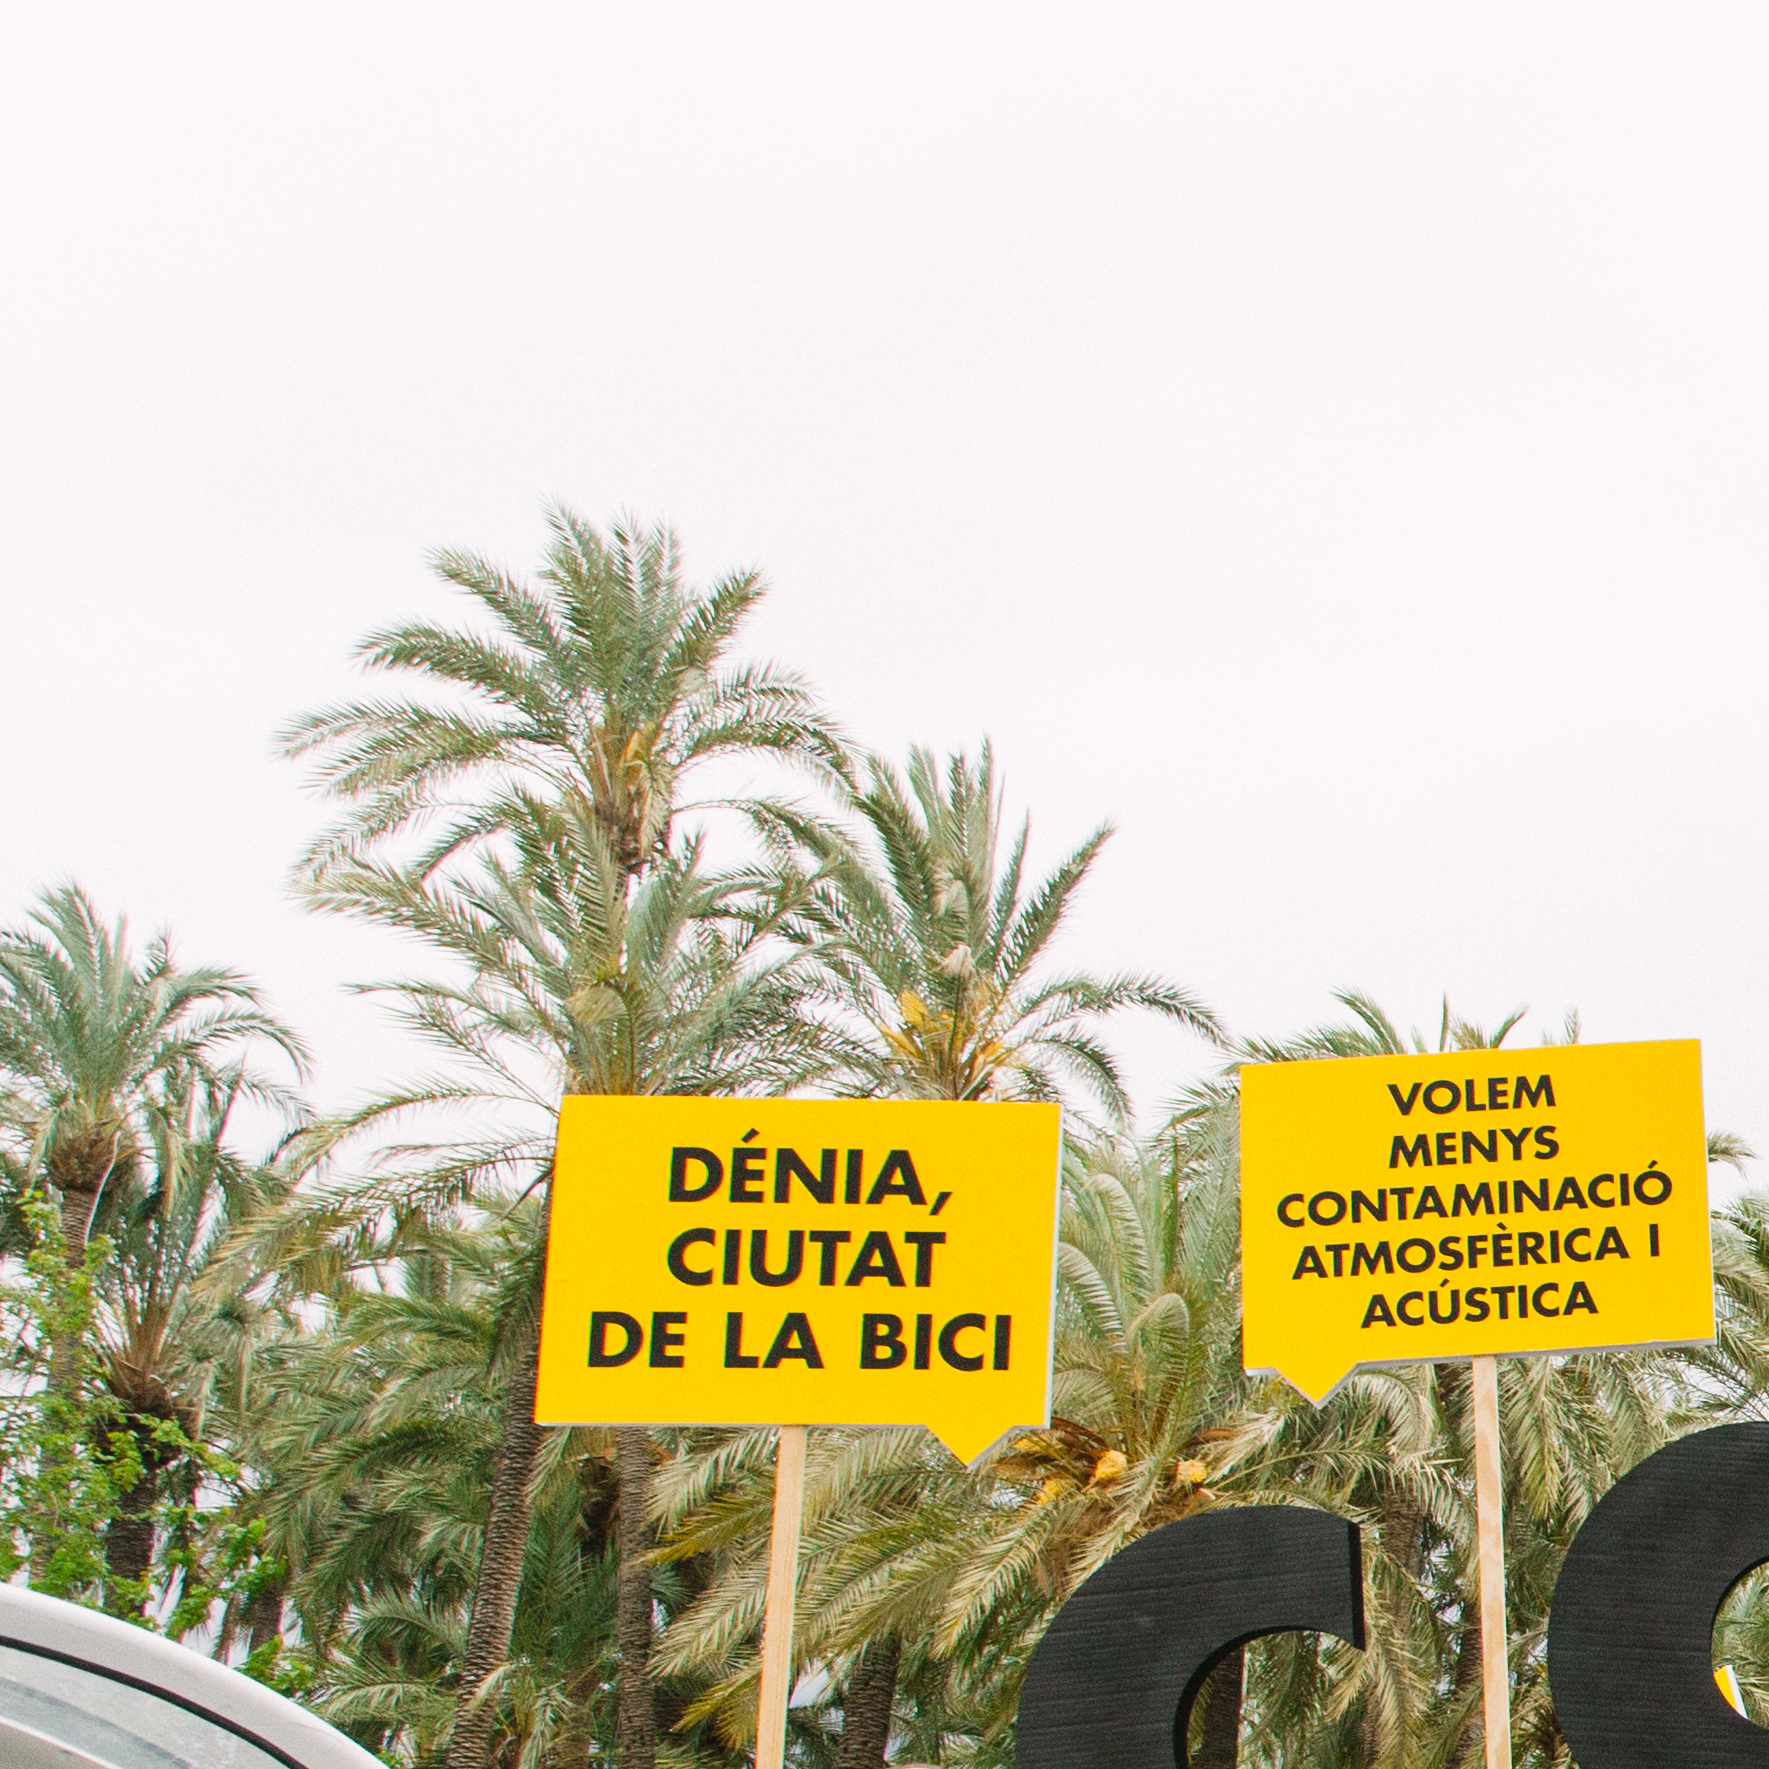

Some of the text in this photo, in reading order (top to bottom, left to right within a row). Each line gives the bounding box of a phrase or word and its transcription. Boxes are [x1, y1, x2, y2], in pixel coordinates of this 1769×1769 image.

[1387, 1075, 1554, 1115] VOLEM
[669, 1129, 950, 1215] DÉNIA,
[1390, 1126, 1558, 1168] MENYS
[1277, 1160, 1671, 1227] CONTAMINACIÓ
[667, 1228, 944, 1286] CIUTAT
[1293, 1222, 1658, 1279] ATMOSFÈRICA I
[1361, 1279, 1597, 1327] ACÚSTICA
[588, 1312, 1010, 1371] DE LA BICI
